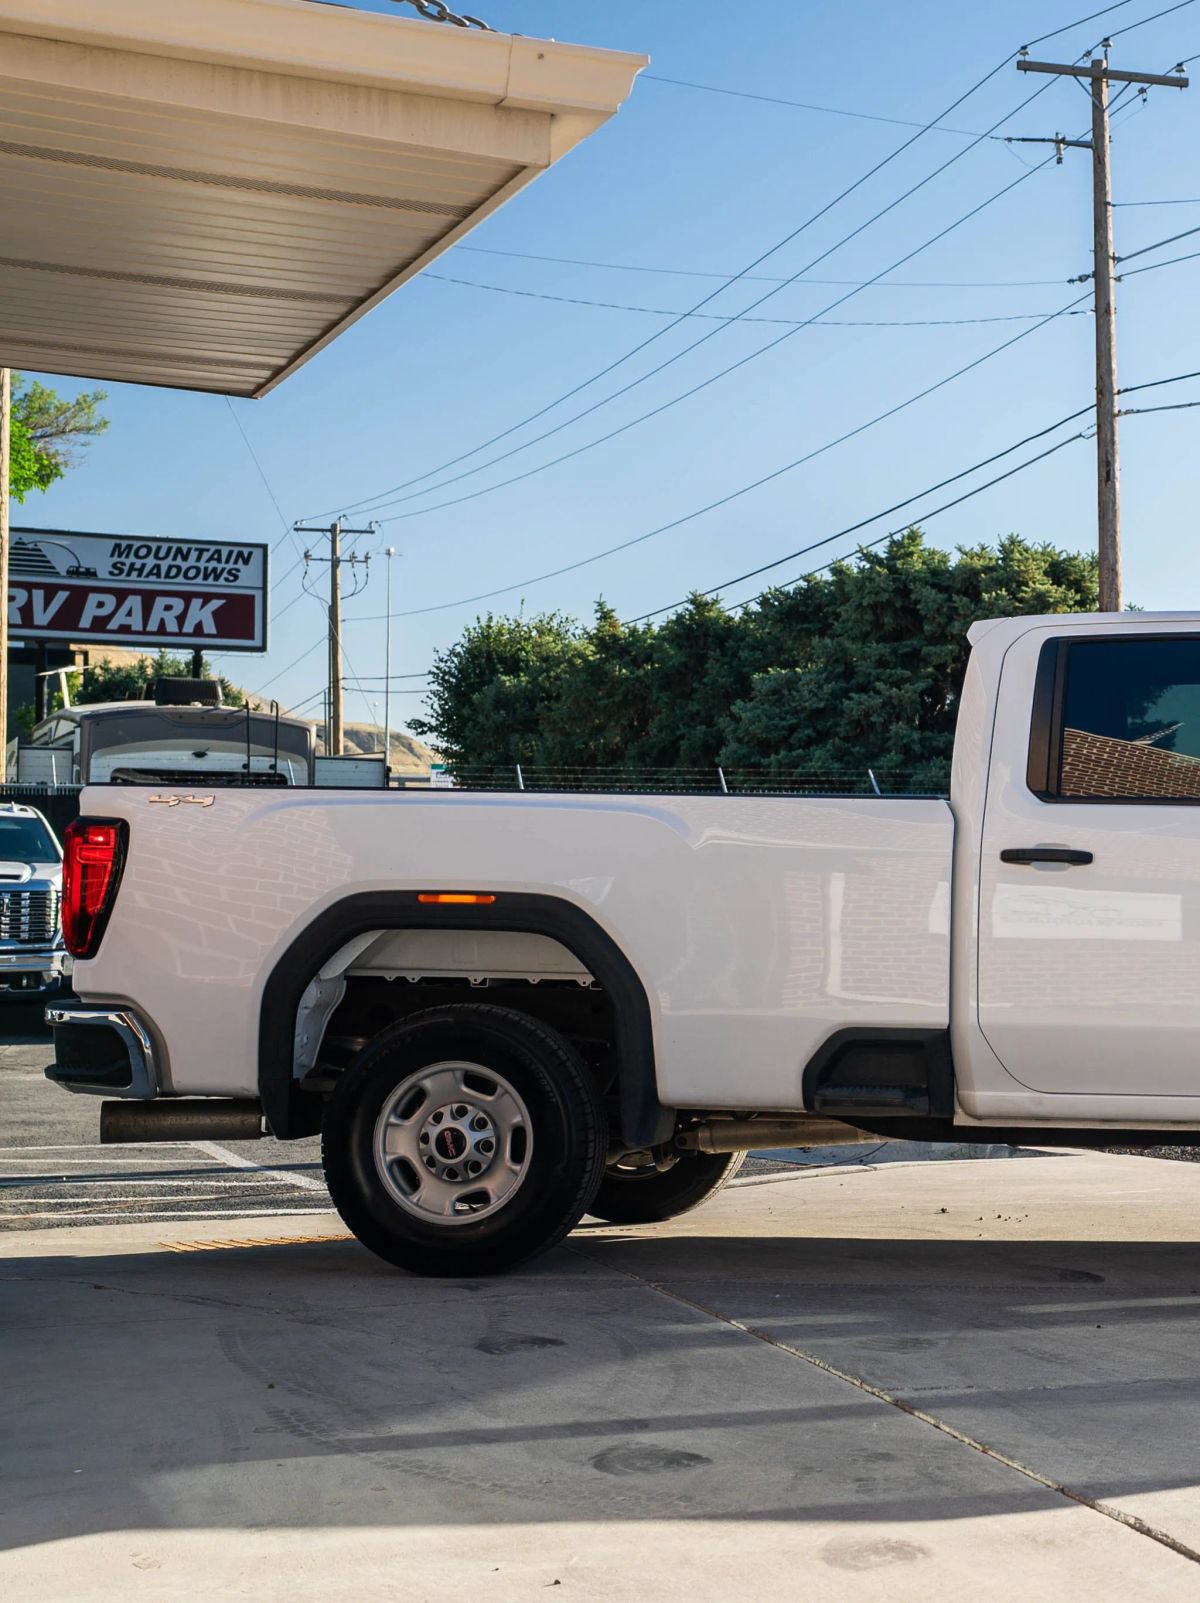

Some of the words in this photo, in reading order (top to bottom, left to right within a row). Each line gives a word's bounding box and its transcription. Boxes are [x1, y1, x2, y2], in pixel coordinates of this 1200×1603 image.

[110, 543, 253, 566] MOUNTAIN
[108, 562, 240, 582] SHADOWS
[8, 587, 70, 626] RV
[78, 593, 227, 634] PARK
[444, 1130, 456, 1157] GMC
